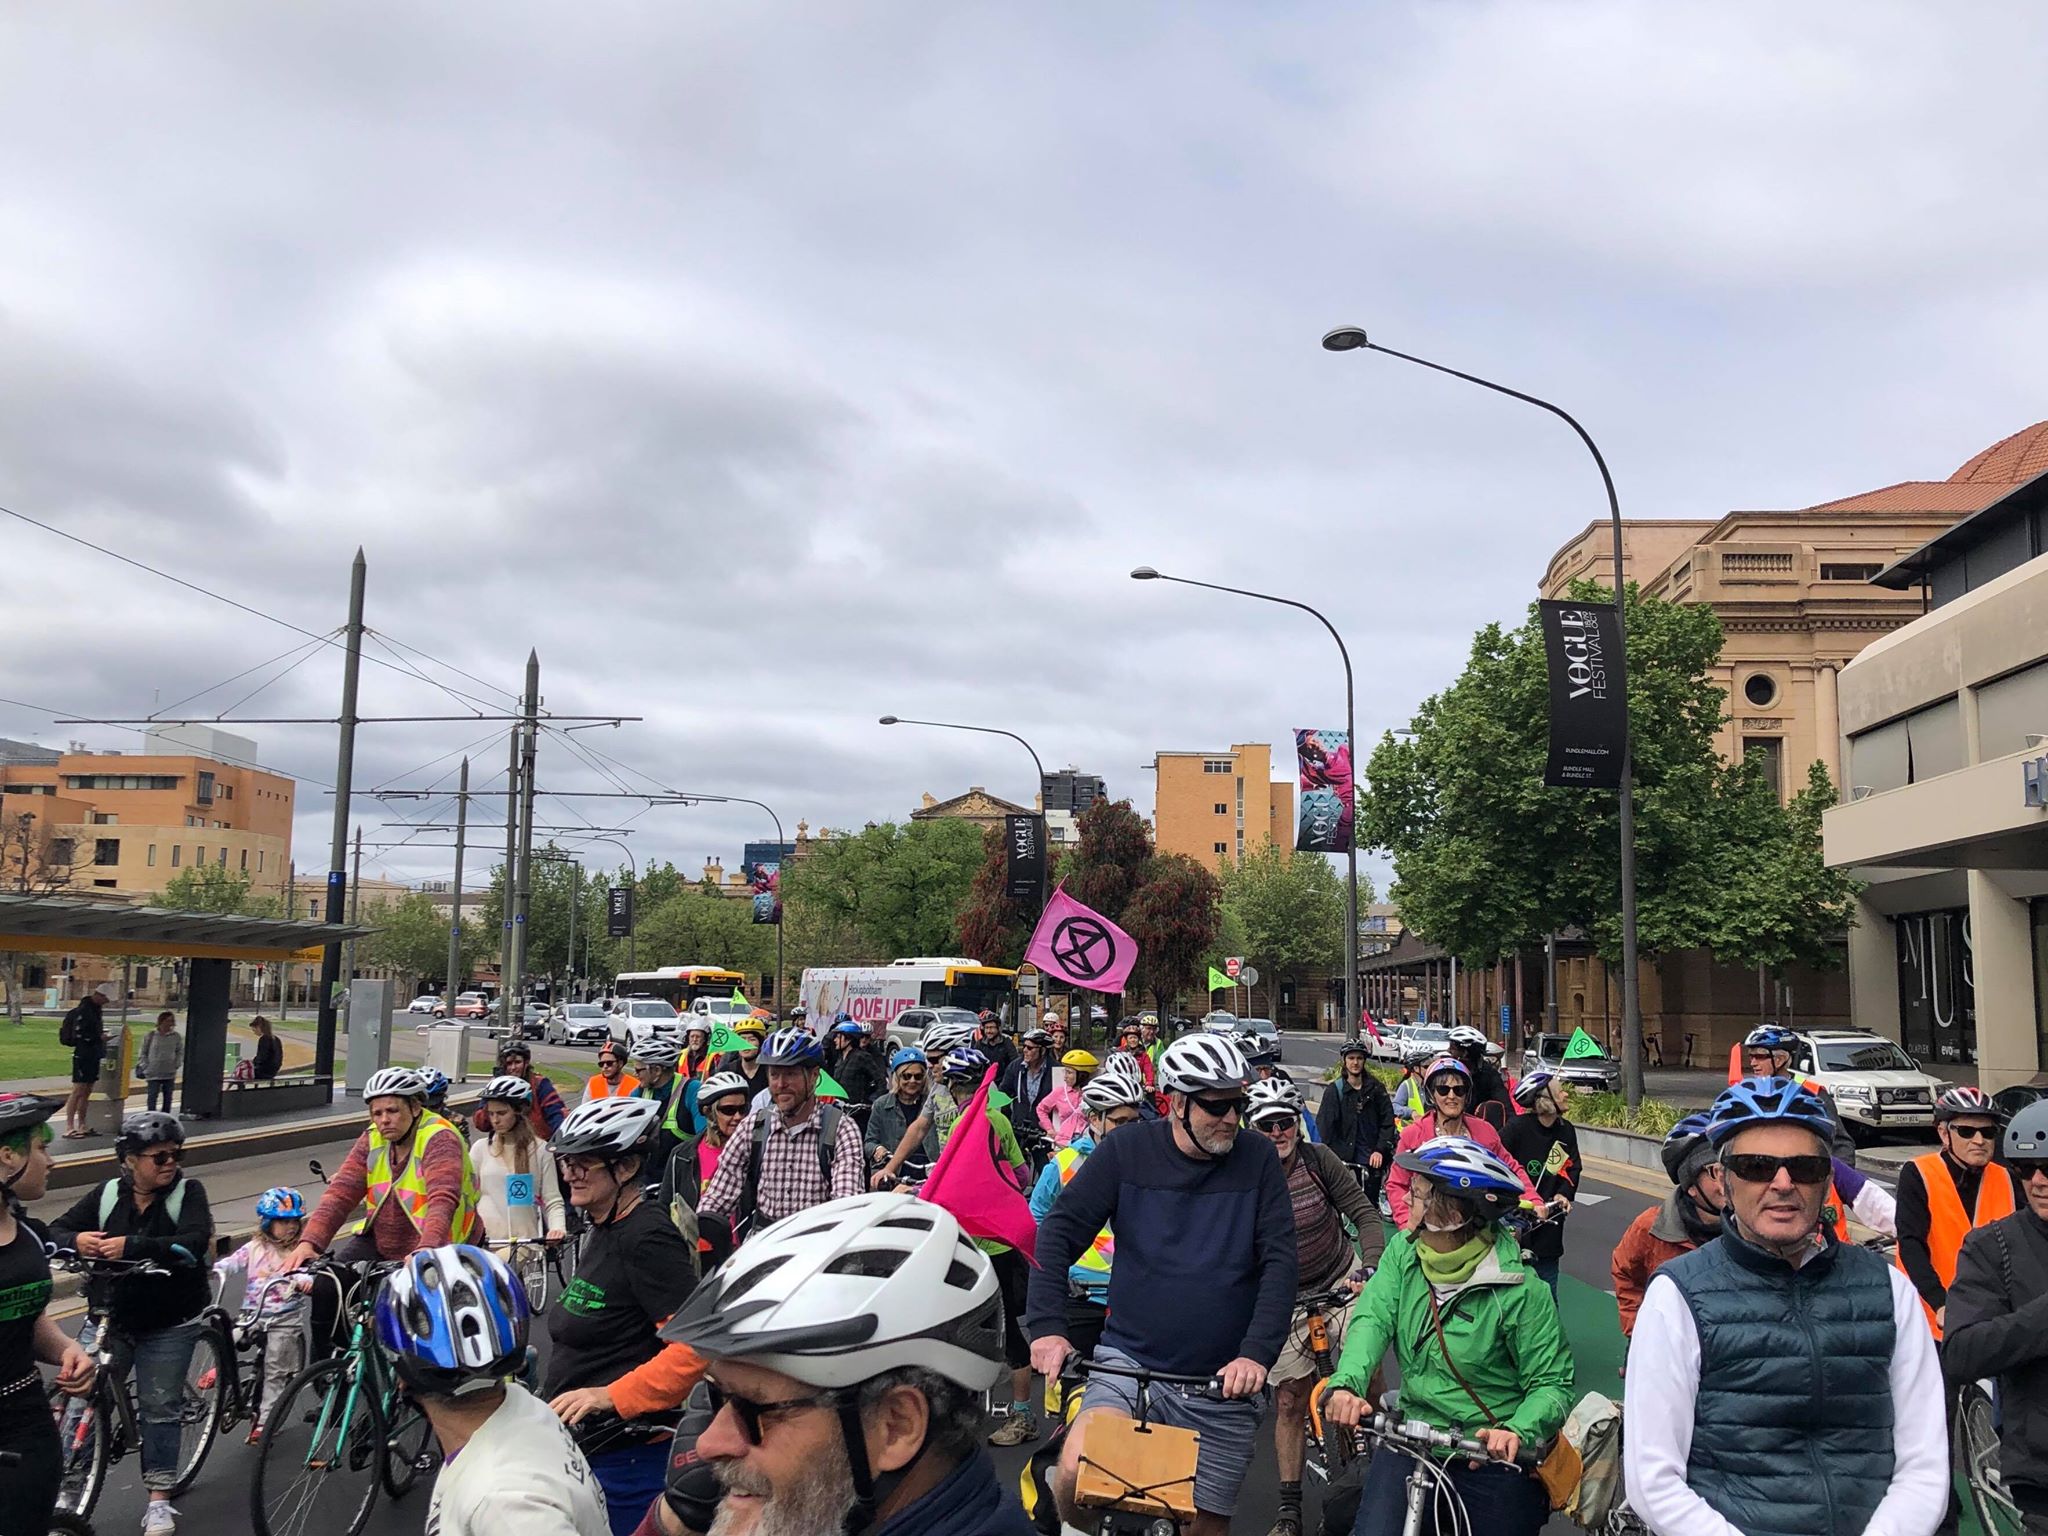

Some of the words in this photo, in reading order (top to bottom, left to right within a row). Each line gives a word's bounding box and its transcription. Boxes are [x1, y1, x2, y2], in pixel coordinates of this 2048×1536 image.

[1589, 611, 1599, 629] OCT
[1559, 610, 1592, 701] VOGUE
[1587, 629, 1607, 700] FESTIVAL
[1014, 818, 1028, 859] VOGUE
[1026, 826, 1035, 859] FESTIVAL
[1902, 913, 1975, 1028] MUS
[847, 997, 883, 1021] LOVE
[1162, 1068, 1178, 1084] MET
[672, 1448, 698, 1469] GE
